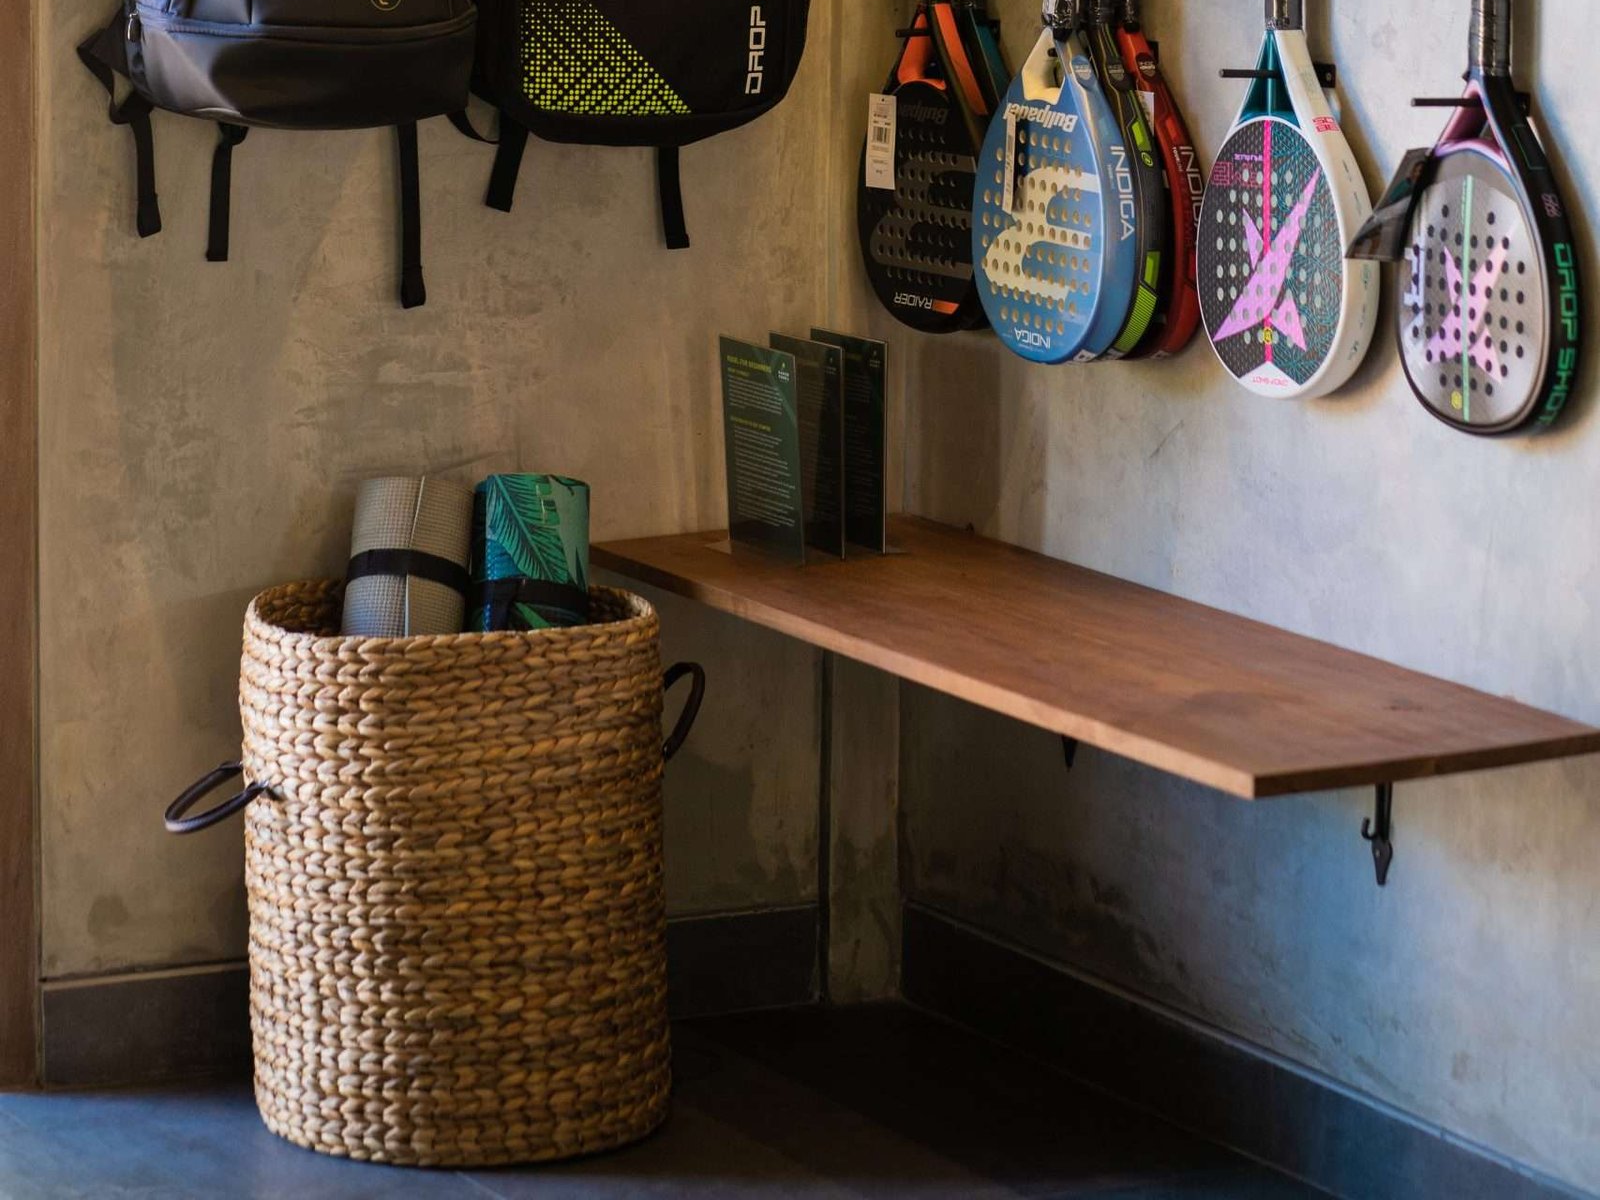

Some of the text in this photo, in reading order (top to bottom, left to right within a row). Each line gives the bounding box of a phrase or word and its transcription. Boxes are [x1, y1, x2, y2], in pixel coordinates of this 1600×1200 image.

[746, 5, 768, 94] DROP
[1002, 103, 1078, 133] Bullpadel
[1110, 145, 1135, 241] INDIGA
[1179, 145, 1204, 240] INDIG
[893, 292, 933, 310] RAIDER
[1553, 242, 1580, 342] DROP
[1014, 327, 1051, 349] INDIGA
